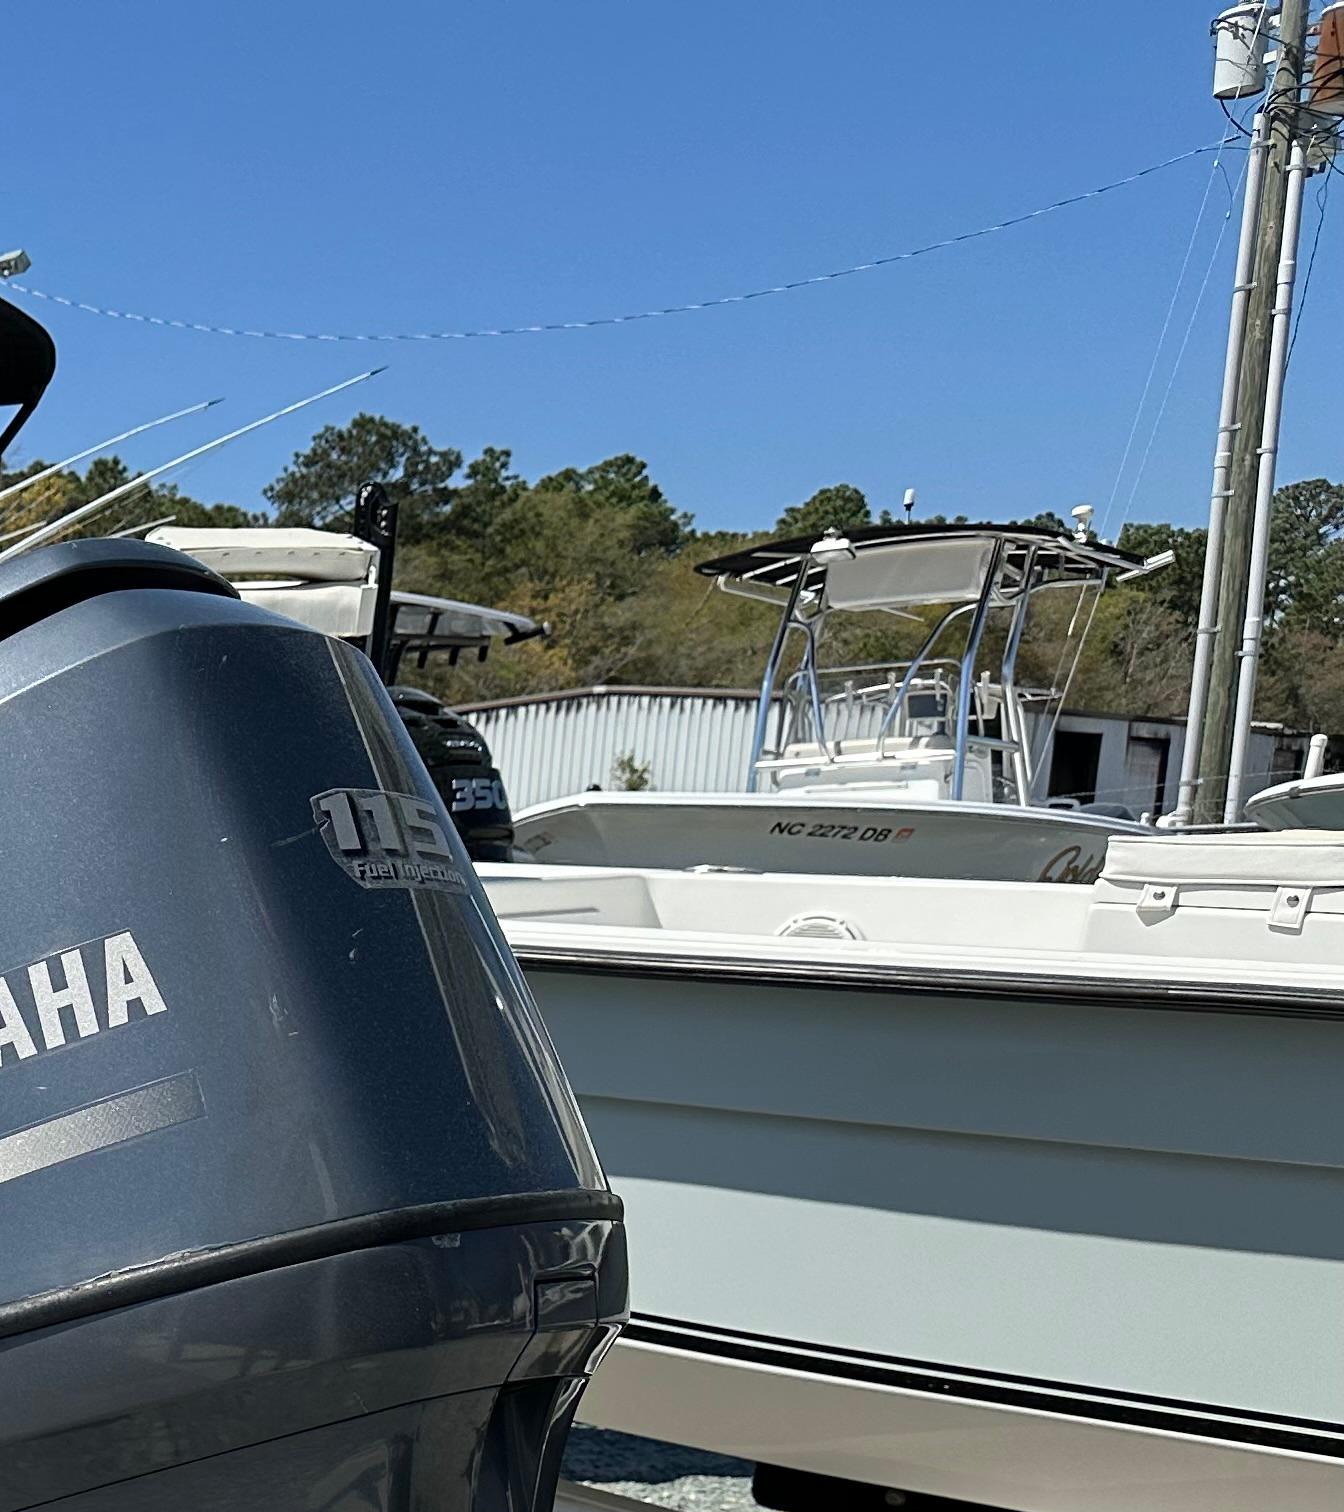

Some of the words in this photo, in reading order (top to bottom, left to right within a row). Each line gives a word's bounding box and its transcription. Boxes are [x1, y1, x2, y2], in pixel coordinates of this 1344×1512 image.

[451, 777, 506, 812] 350
[319, 791, 453, 862] 115
[769, 822, 806, 836] NC
[806, 823, 859, 840] 2272
[859, 827, 893, 842] DB
[353, 860, 395, 879] Fuel
[398, 863, 467, 887] Injection
